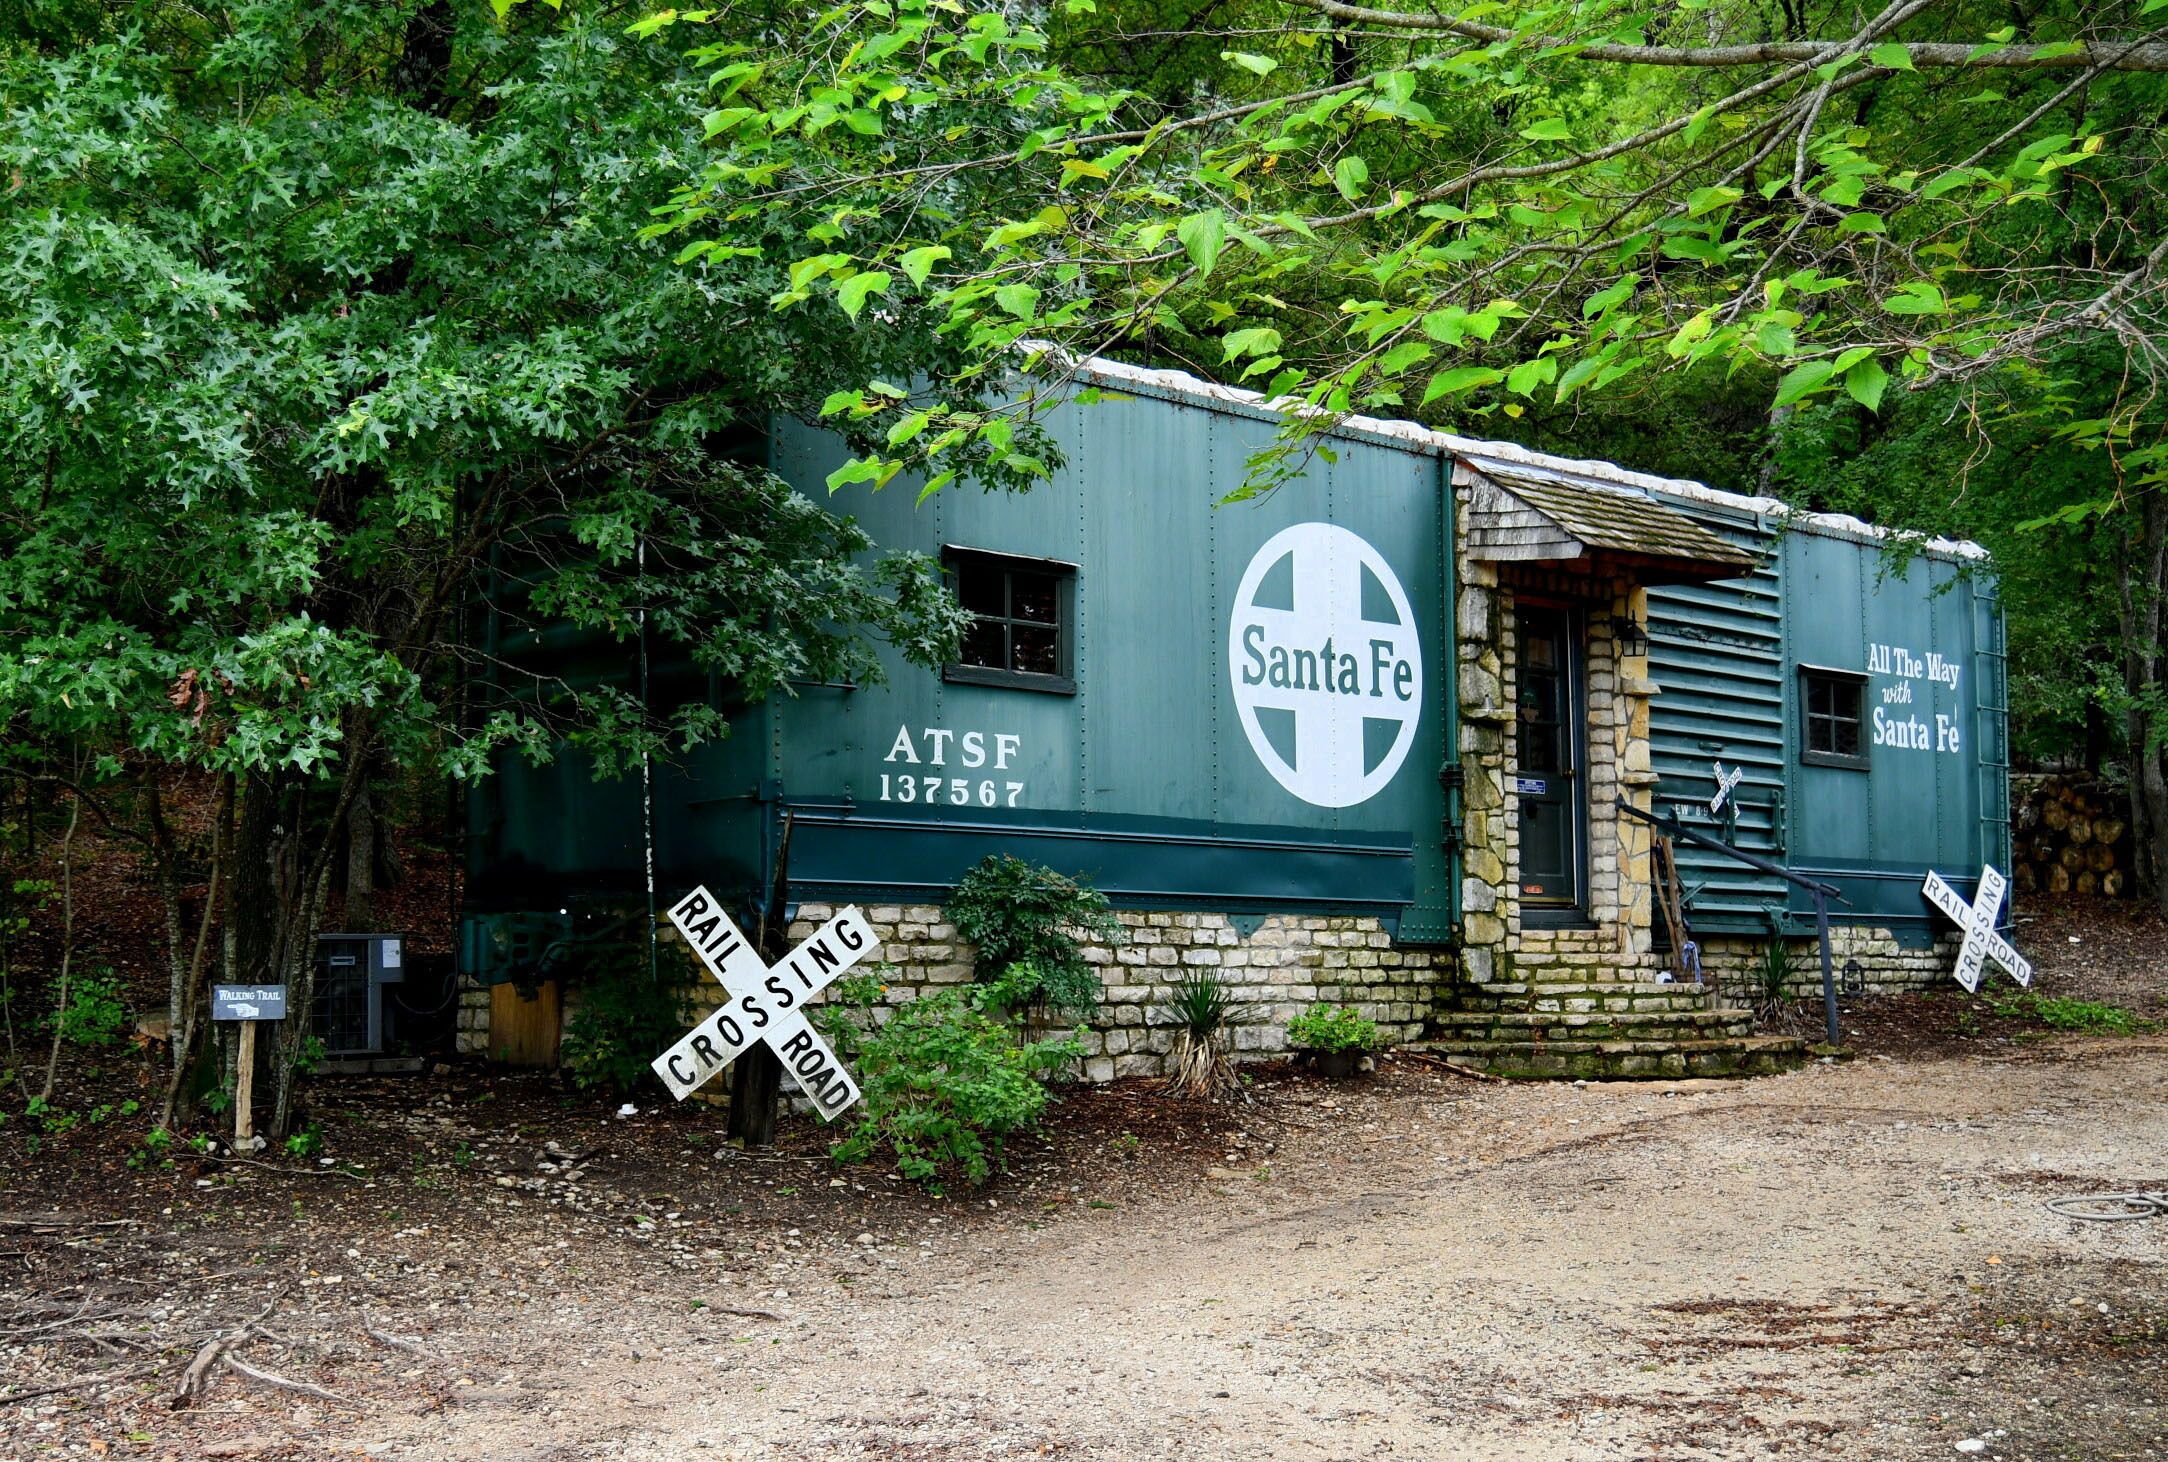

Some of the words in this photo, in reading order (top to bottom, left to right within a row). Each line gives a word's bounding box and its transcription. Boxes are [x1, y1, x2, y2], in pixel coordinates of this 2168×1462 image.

[1242, 623, 1361, 696] Santa
[1369, 639, 1412, 702] Fe
[1867, 643, 1891, 674] All
[1893, 647, 1923, 679] The
[1925, 652, 1960, 691] Way
[1882, 680, 1912, 704] with
[883, 724, 1021, 769] ATSF
[1873, 706, 1930, 750] Santa
[879, 774, 1024, 808] 137567
[1927, 878, 1966, 926] RAIL
[675, 893, 741, 974] RAIL
[1960, 873, 2001, 985] CROSSING
[1987, 935, 2027, 980] ROAD
[218, 990, 255, 1001] WALKING
[256, 990, 281, 1000] TRAIL
[667, 919, 864, 1086] CROSSING
[780, 1029, 850, 1110] ROAD
